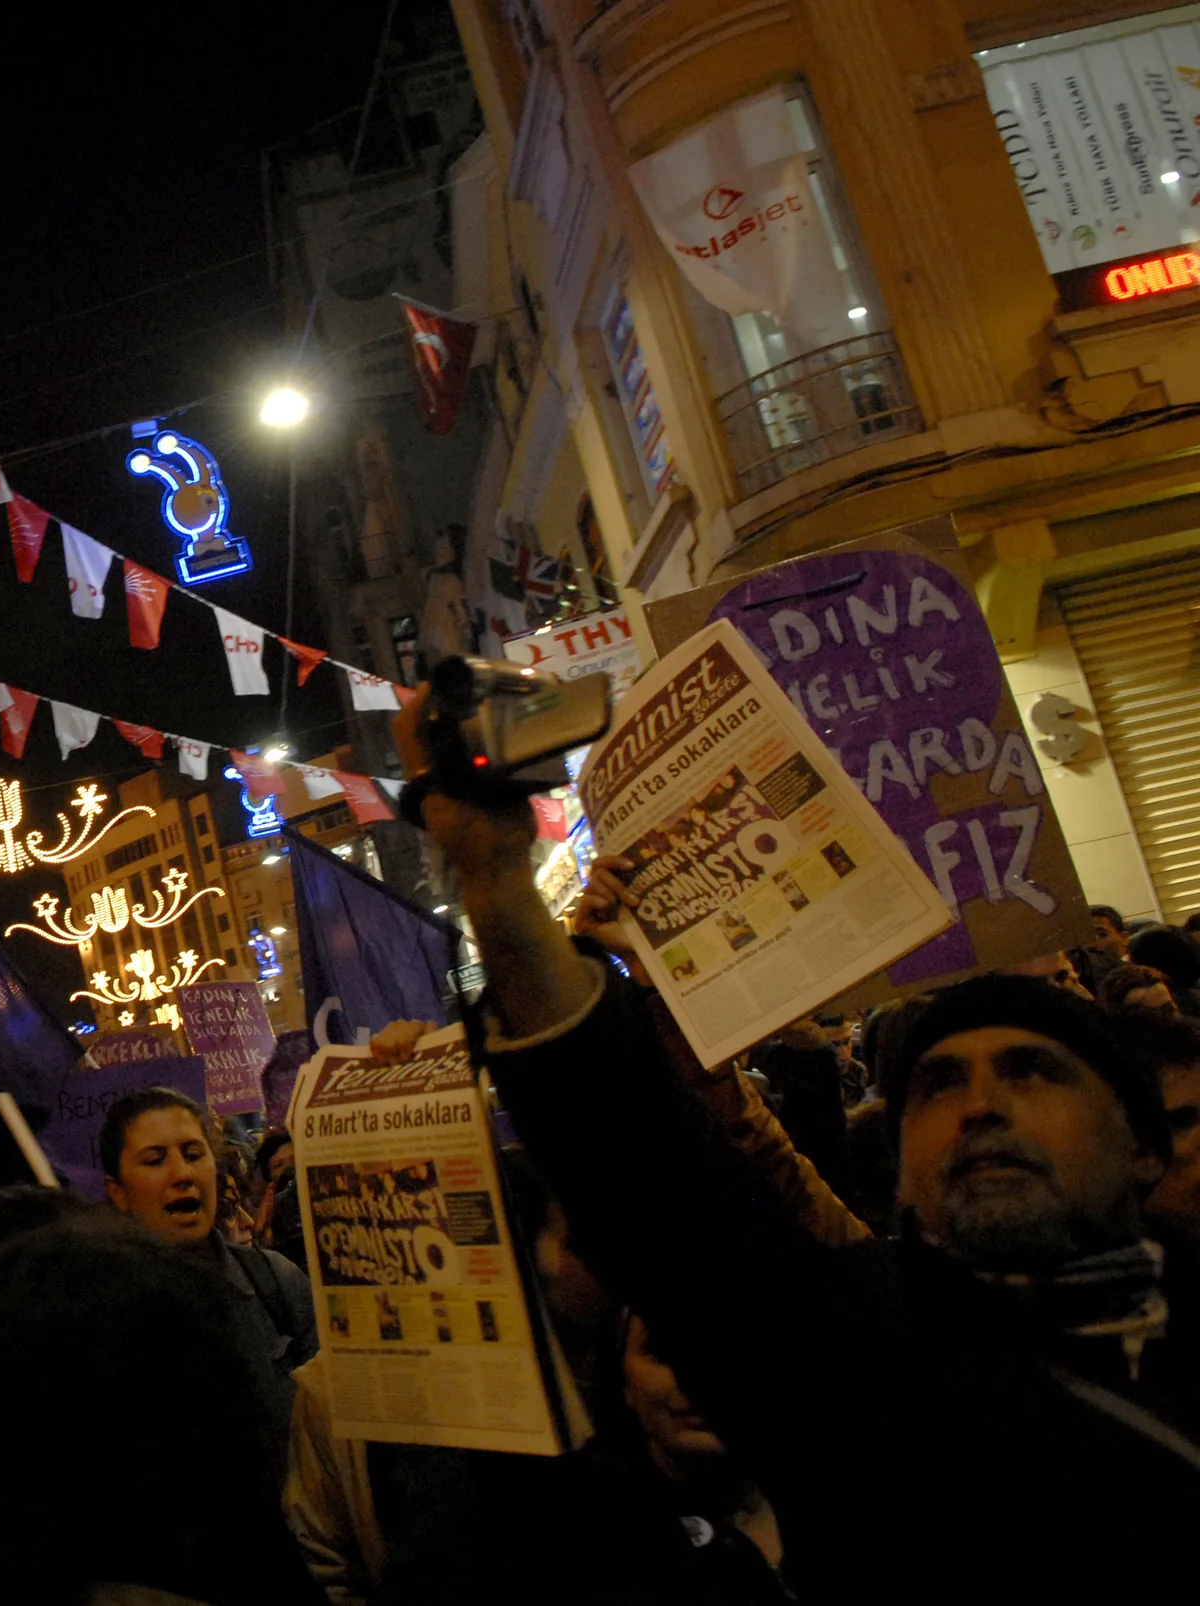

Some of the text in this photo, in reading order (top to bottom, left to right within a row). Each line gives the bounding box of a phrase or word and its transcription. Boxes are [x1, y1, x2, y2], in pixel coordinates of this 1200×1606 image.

[994, 108, 1048, 206] TCDD
[1064, 74, 1123, 213] TÜRK HAVA YOLLARI
[553, 616, 633, 656] THY
[586, 656, 723, 806] feminist
[664, 695, 762, 778] sokaklara
[690, 671, 742, 722] gazete
[303, 1115, 316, 1138] 8
[382, 1100, 471, 1130] sokaklara
